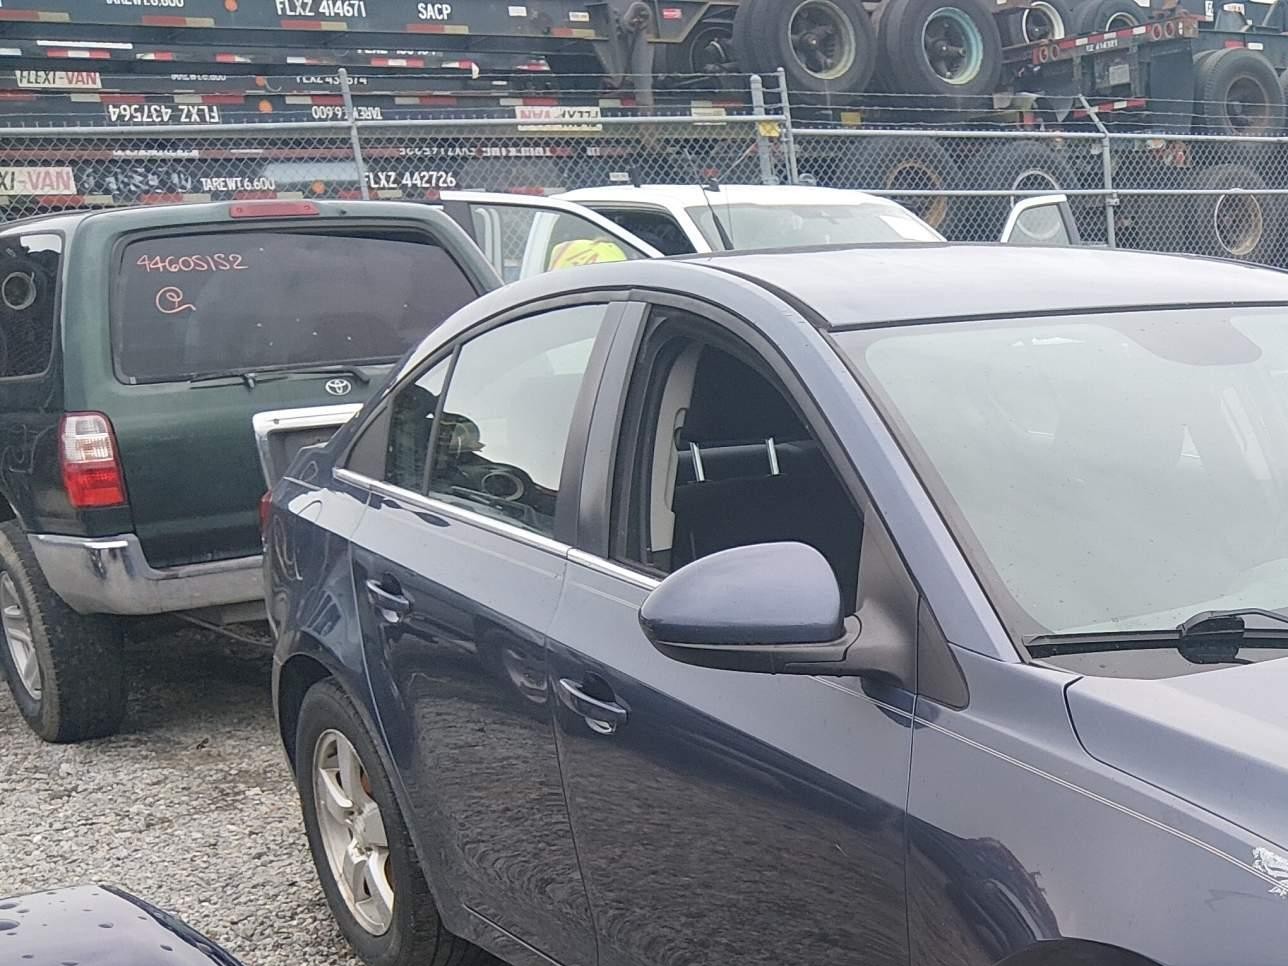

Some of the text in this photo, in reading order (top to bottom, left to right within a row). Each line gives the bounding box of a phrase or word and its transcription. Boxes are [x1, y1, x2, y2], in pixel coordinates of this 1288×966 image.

[276, 0, 366, 17] FLXZ 414671
[418, 3, 451, 20] SACP
[108, 104, 220, 123] FLXZ 437564
[402, 172, 457, 188] 442726
[136, 253, 249, 273] 44605152
